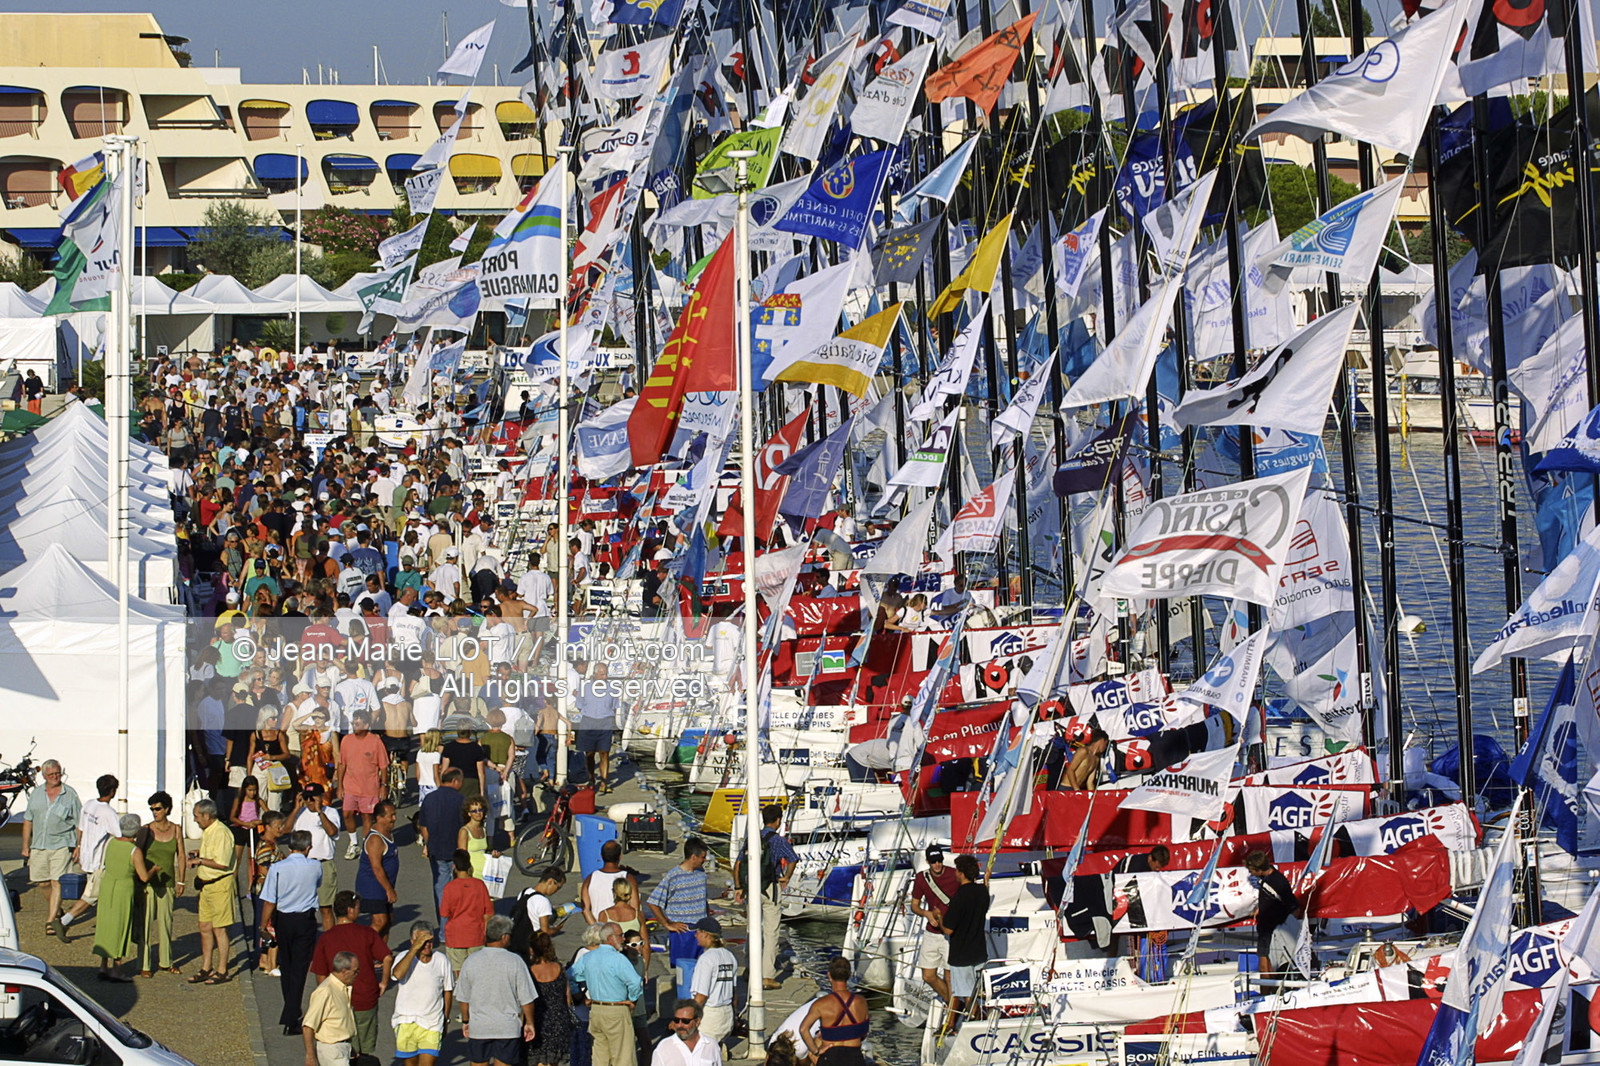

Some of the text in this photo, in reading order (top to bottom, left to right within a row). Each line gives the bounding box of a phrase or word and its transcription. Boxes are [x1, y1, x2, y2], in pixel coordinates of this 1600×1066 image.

[1096, 686, 1128, 710] AGF
[1130, 709, 1167, 733] AGF
[943, 732, 958, 742] en
[1269, 805, 1314, 828] AGF
[1382, 822, 1427, 849] AGF
[1510, 946, 1559, 977] AGF
[992, 980, 1030, 993] SONY
[1093, 977, 1127, 991] CASSIS
[970, 1032, 1119, 1055] CASSIS
